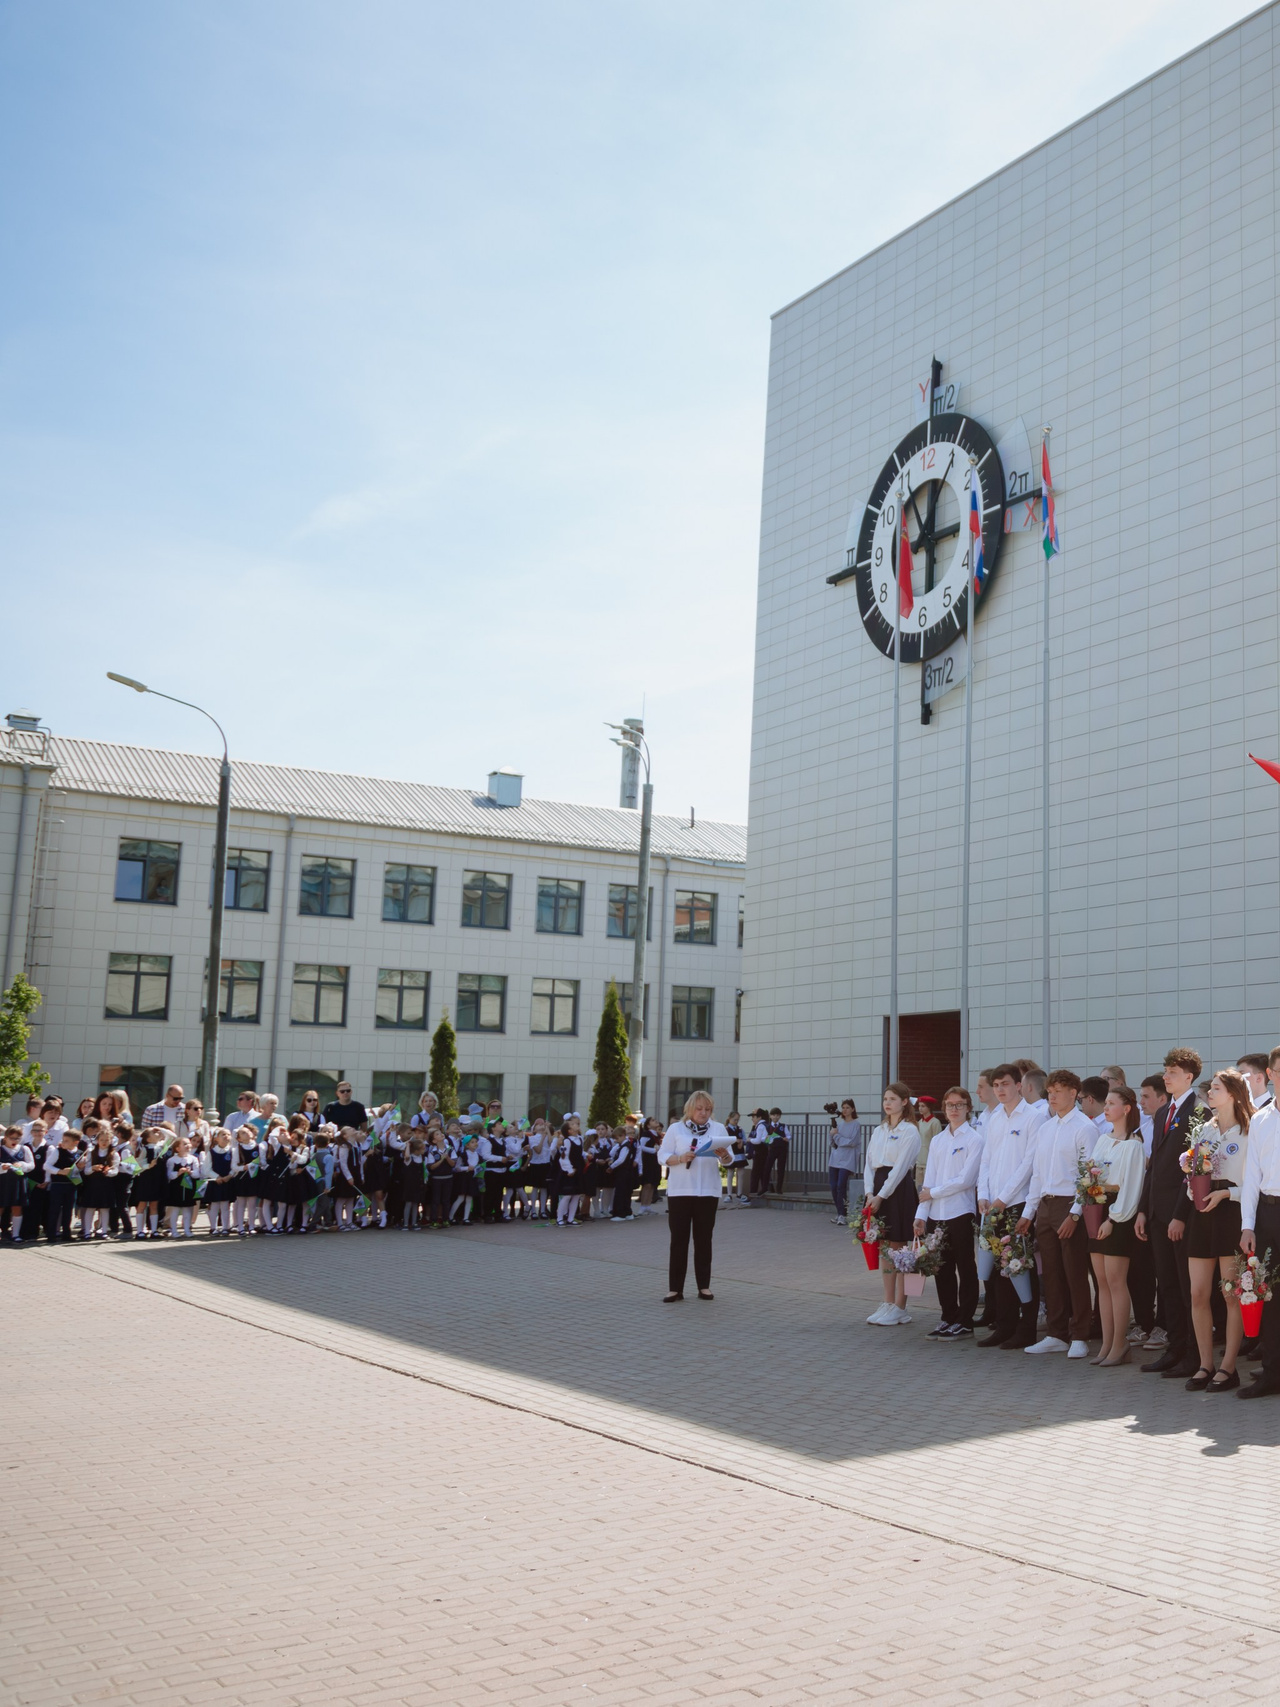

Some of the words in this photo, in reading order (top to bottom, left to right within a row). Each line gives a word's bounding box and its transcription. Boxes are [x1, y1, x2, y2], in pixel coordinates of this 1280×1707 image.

[918, 377, 931, 404] Y
[920, 447, 936, 471] 12
[899, 468, 911, 490] 11
[1008, 470, 1029, 498] 2π
[880, 504, 896, 528] 10
[1022, 497, 1038, 527] X
[874, 546, 883, 567] 9
[879, 582, 888, 604] 8
[942, 586, 952, 608] 5
[918, 606, 927, 628] 6
[924, 656, 954, 690] 3π/2
